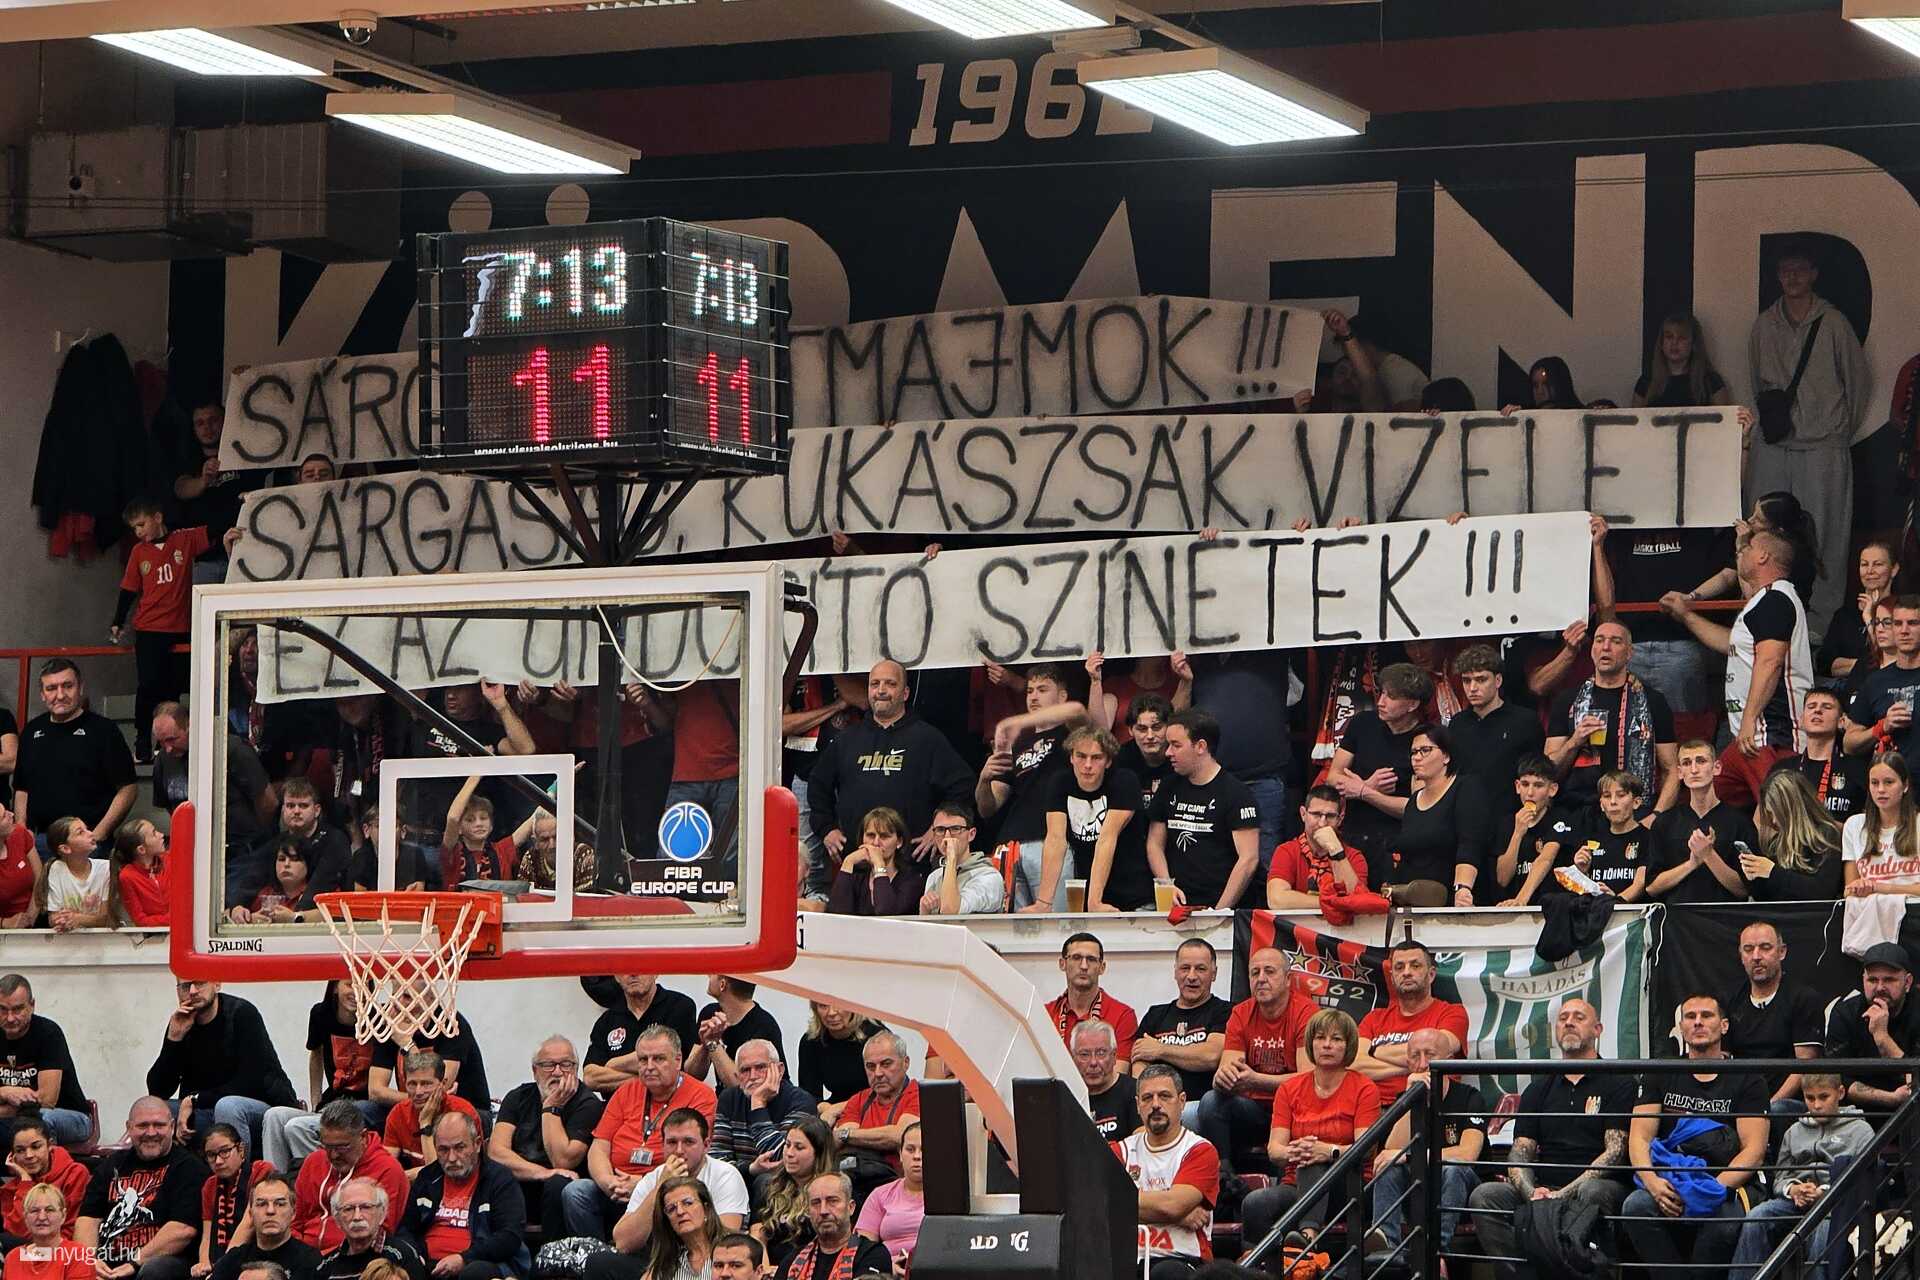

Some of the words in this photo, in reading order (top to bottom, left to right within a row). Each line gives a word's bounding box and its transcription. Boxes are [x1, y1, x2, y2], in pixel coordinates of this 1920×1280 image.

[504, 244, 627, 321] 7:13
[691, 251, 758, 325] 7:13
[827, 298, 1212, 427] MAJMOK
[157, 563, 173, 584] 10
[522, 556, 932, 683] UDOÍTÓ
[974, 527, 1429, 664] SZÍNETEK
[664, 866, 703, 879] FIBA
[631, 881, 698, 894] EUROPE
[701, 881, 735, 894] CUP
[207, 938, 263, 954] SPALDING
[1159, 1031, 1207, 1046] ÖRMEND
[1664, 1092, 1732, 1113] HUNGARY
